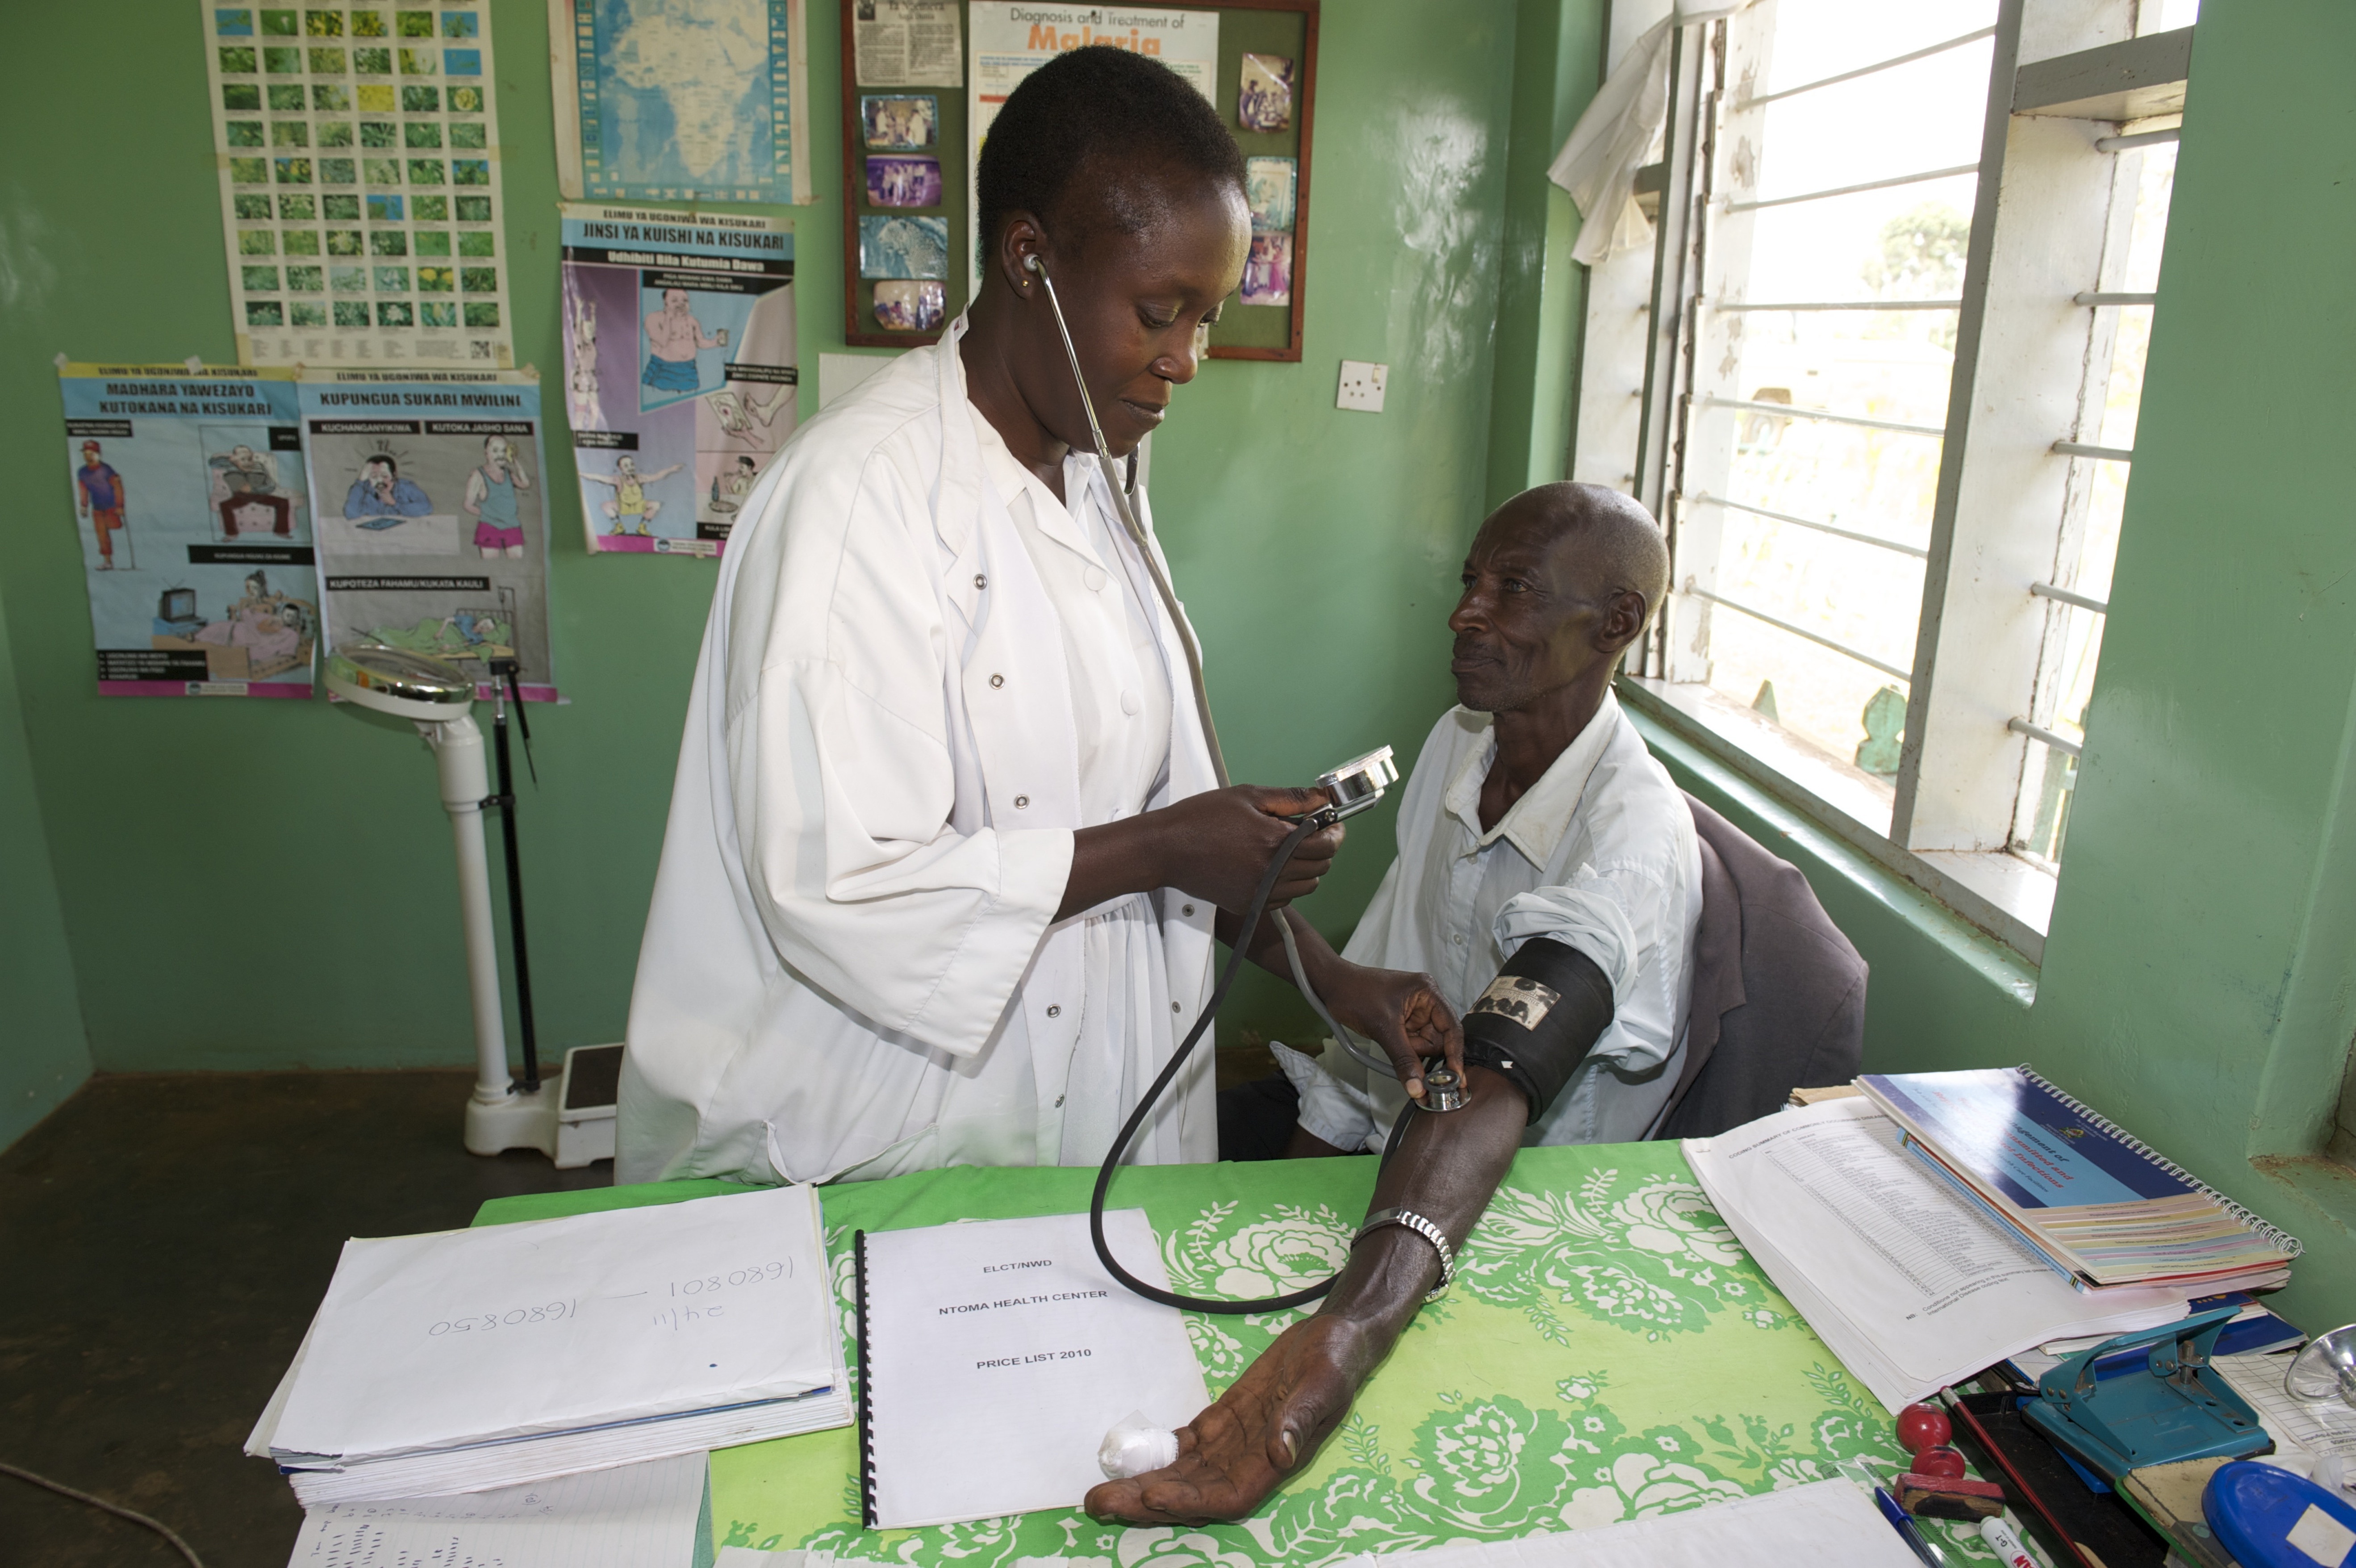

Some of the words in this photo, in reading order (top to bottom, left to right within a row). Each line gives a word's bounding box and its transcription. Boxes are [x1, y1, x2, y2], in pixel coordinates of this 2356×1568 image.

[1011, 8, 1072, 25] Diagnosis
[1078, 10, 1102, 25] and
[1108, 12, 1167, 28] Treatment
[1171, 13, 1185, 28] of
[1028, 25, 1160, 55] Malaria
[604, 209, 633, 219] ELIMU
[635, 211, 647, 220] YA
[700, 216, 715, 225] WA
[718, 217, 765, 228] KISUKARI
[584, 223, 618, 239] JINSI
[623, 226, 639, 240] YA
[643, 227, 691, 244] KUISHI
[697, 231, 714, 245] NA
[719, 232, 784, 250] KISUKARI
[608, 251, 654, 264] Udhibiti
[656, 254, 680, 267] Bila
[681, 255, 730, 269] Kutumia
[732, 259, 764, 272] Dawa
[107, 384, 178, 396] MADHARA
[180, 384, 255, 397] YAWEZAYO
[321, 393, 400, 406] KUPUNGUA
[404, 393, 458, 406] SUKARI
[461, 394, 521, 407] MWILINI
[100, 401, 177, 414] KUTOKANA
[180, 401, 199, 414] NA
[203, 402, 272, 415] KISUKARI
[322, 423, 412, 433] KUCHANGANYIKIWA
[432, 423, 470, 431] KUTOKA
[472, 424, 501, 433] JASHO
[503, 425, 528, 433] SANA
[330, 579, 379, 588] KUPOTEZA
[456, 580, 483, 588] KAULI
[1729, 1146, 1752, 1159] CODING
[1752, 1133, 1782, 1149] SUMMARY
[1792, 1121, 1825, 1132] COMMONLY
[2008, 1119, 2056, 1154] nagement
[2003, 1128, 2054, 1166] ansmitted
[2051, 1167, 2074, 1180] and
[2013, 1153, 2064, 1188] Infections
[670, 1256, 794, 1298] 1680801
[983, 1260, 1052, 1274] ELCT/NWD
[939, 1302, 990, 1315] NTOMA
[994, 1295, 1048, 1309] HEALTH
[1052, 1290, 1108, 1302] CENTER
[1922, 1295, 1950, 1312] Conditions
[1959, 1279, 1986, 1292] appearing
[1927, 1296, 1959, 1316] International
[1959, 1286, 1981, 1298] Disease
[1981, 1280, 1999, 1288] coding
[428, 1298, 576, 1336] 1680850
[977, 1358, 1021, 1369] PRICE
[1024, 1353, 1055, 1364] LIST
[1060, 1349, 1091, 1359] 2010
[1995, 1535, 2007, 1547] G-T
